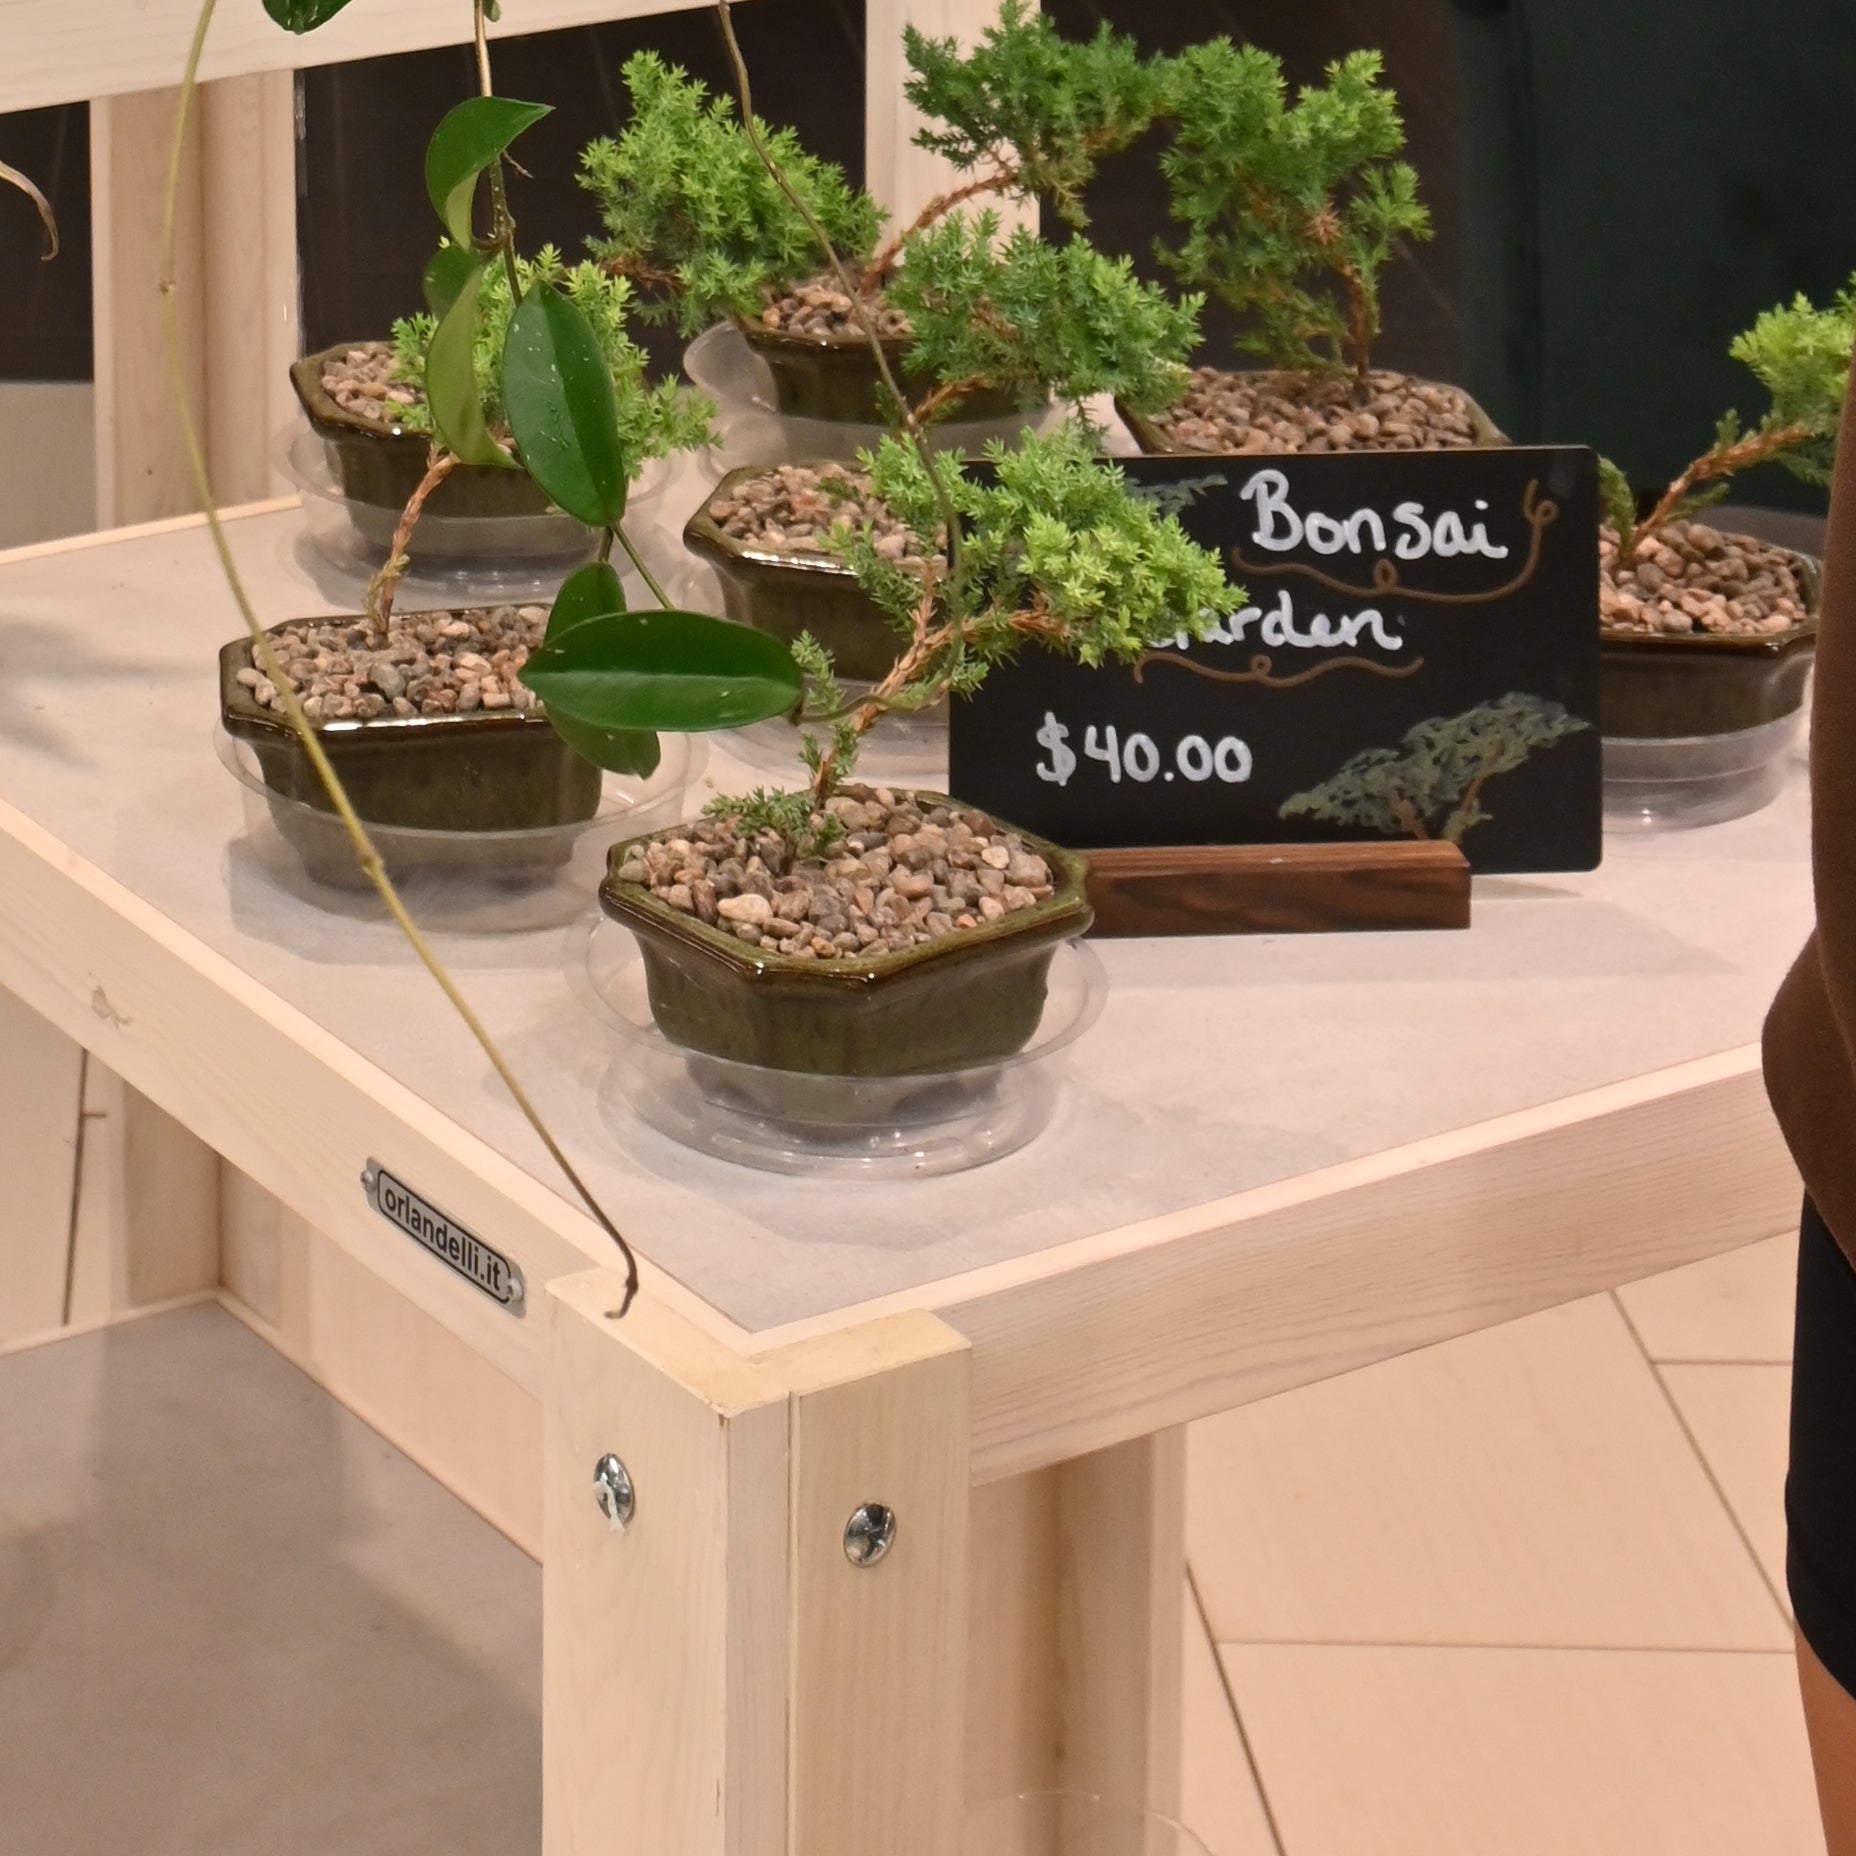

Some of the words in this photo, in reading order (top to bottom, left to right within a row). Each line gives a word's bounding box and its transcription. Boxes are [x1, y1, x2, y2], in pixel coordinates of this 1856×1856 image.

[1239, 469, 1508, 560] Bonsai
[1147, 589, 1403, 651] arden
[1036, 711, 1253, 787] $40.00
[384, 1187, 501, 1291] orlandelli.it
